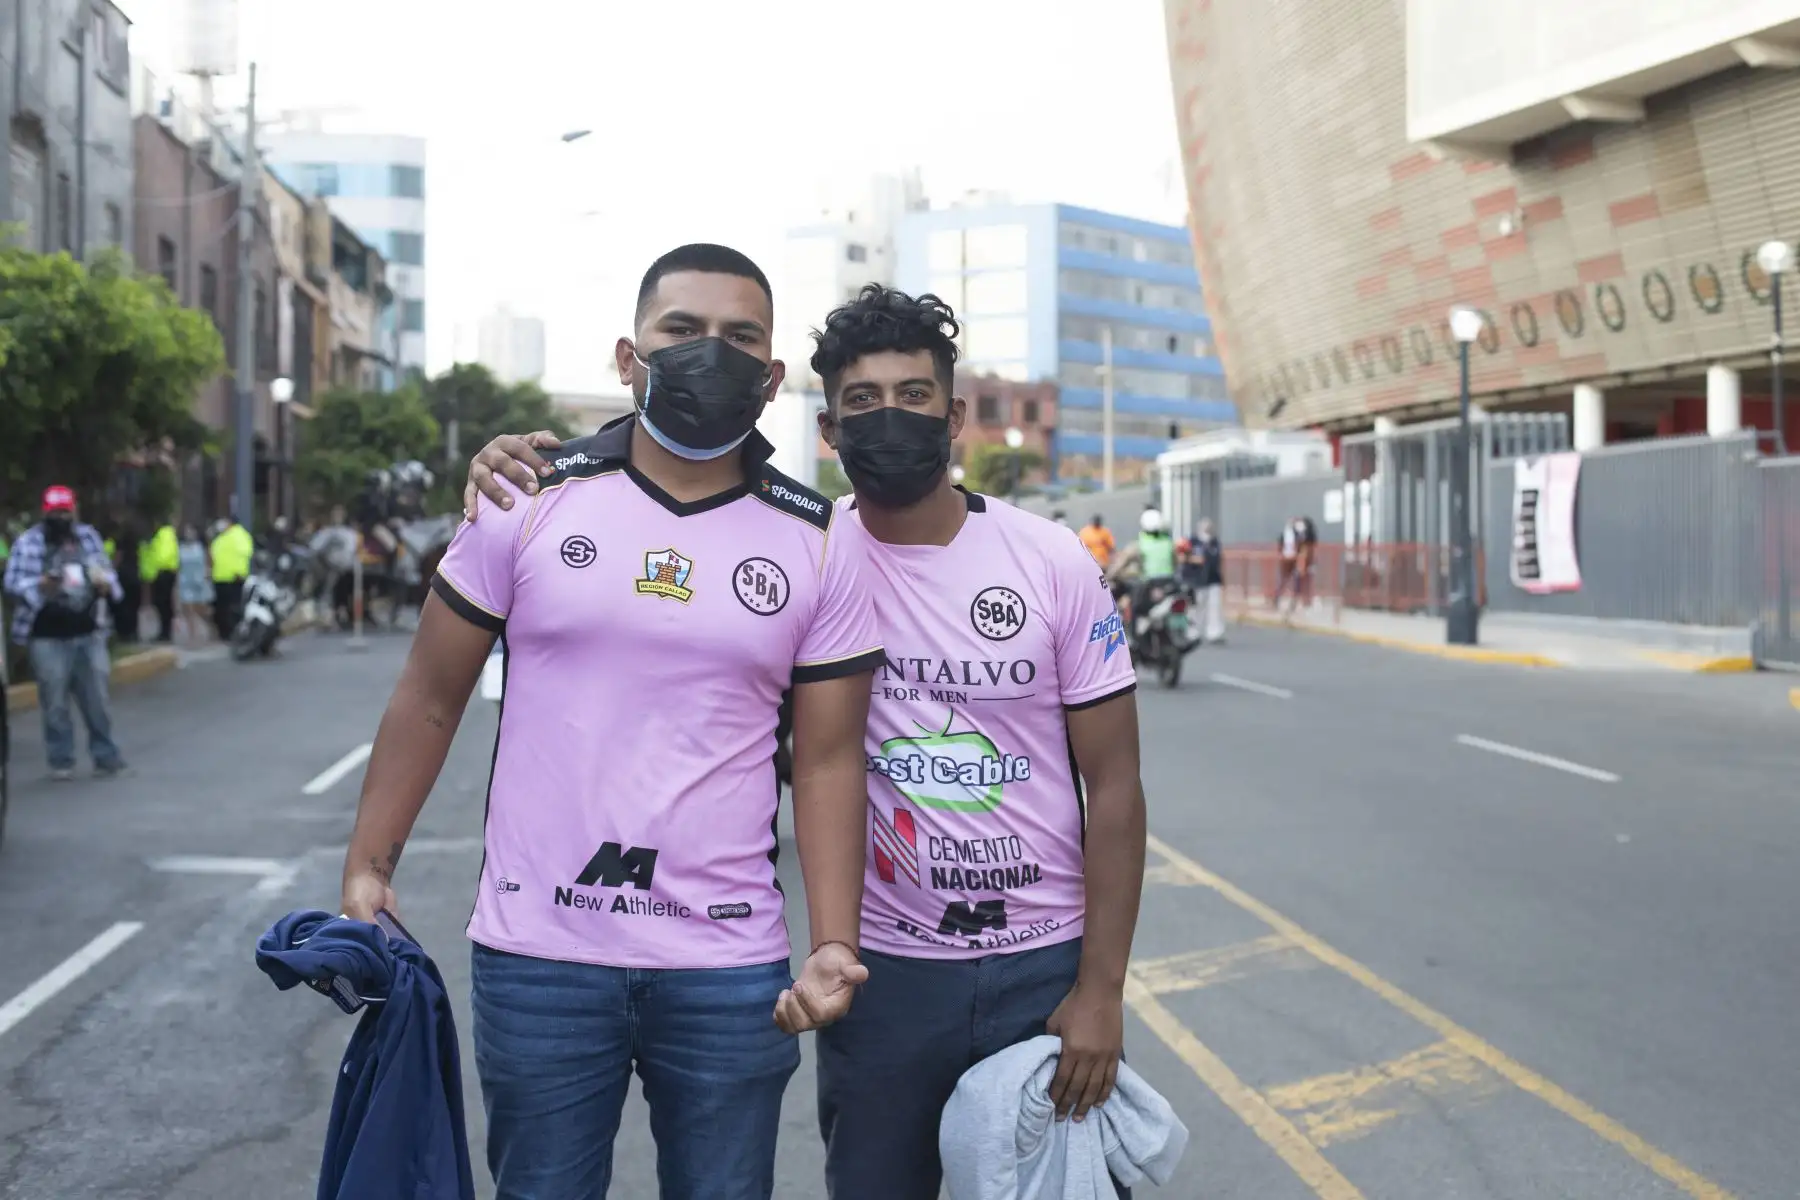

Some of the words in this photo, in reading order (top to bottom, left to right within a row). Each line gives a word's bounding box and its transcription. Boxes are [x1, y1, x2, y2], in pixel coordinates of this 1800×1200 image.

[771, 485, 823, 515] SPORADE
[743, 564, 778, 607] SBA
[977, 599, 1019, 627] SBA
[872, 657, 1036, 686] NTALVO
[883, 687, 921, 701] FOR
[929, 689, 968, 704] MEN
[932, 753, 1031, 786] Cable
[929, 835, 1022, 864] CEMENTO
[931, 863, 1042, 891] NACIONAL
[554, 886, 603, 911] New
[610, 894, 691, 918] Athletic
